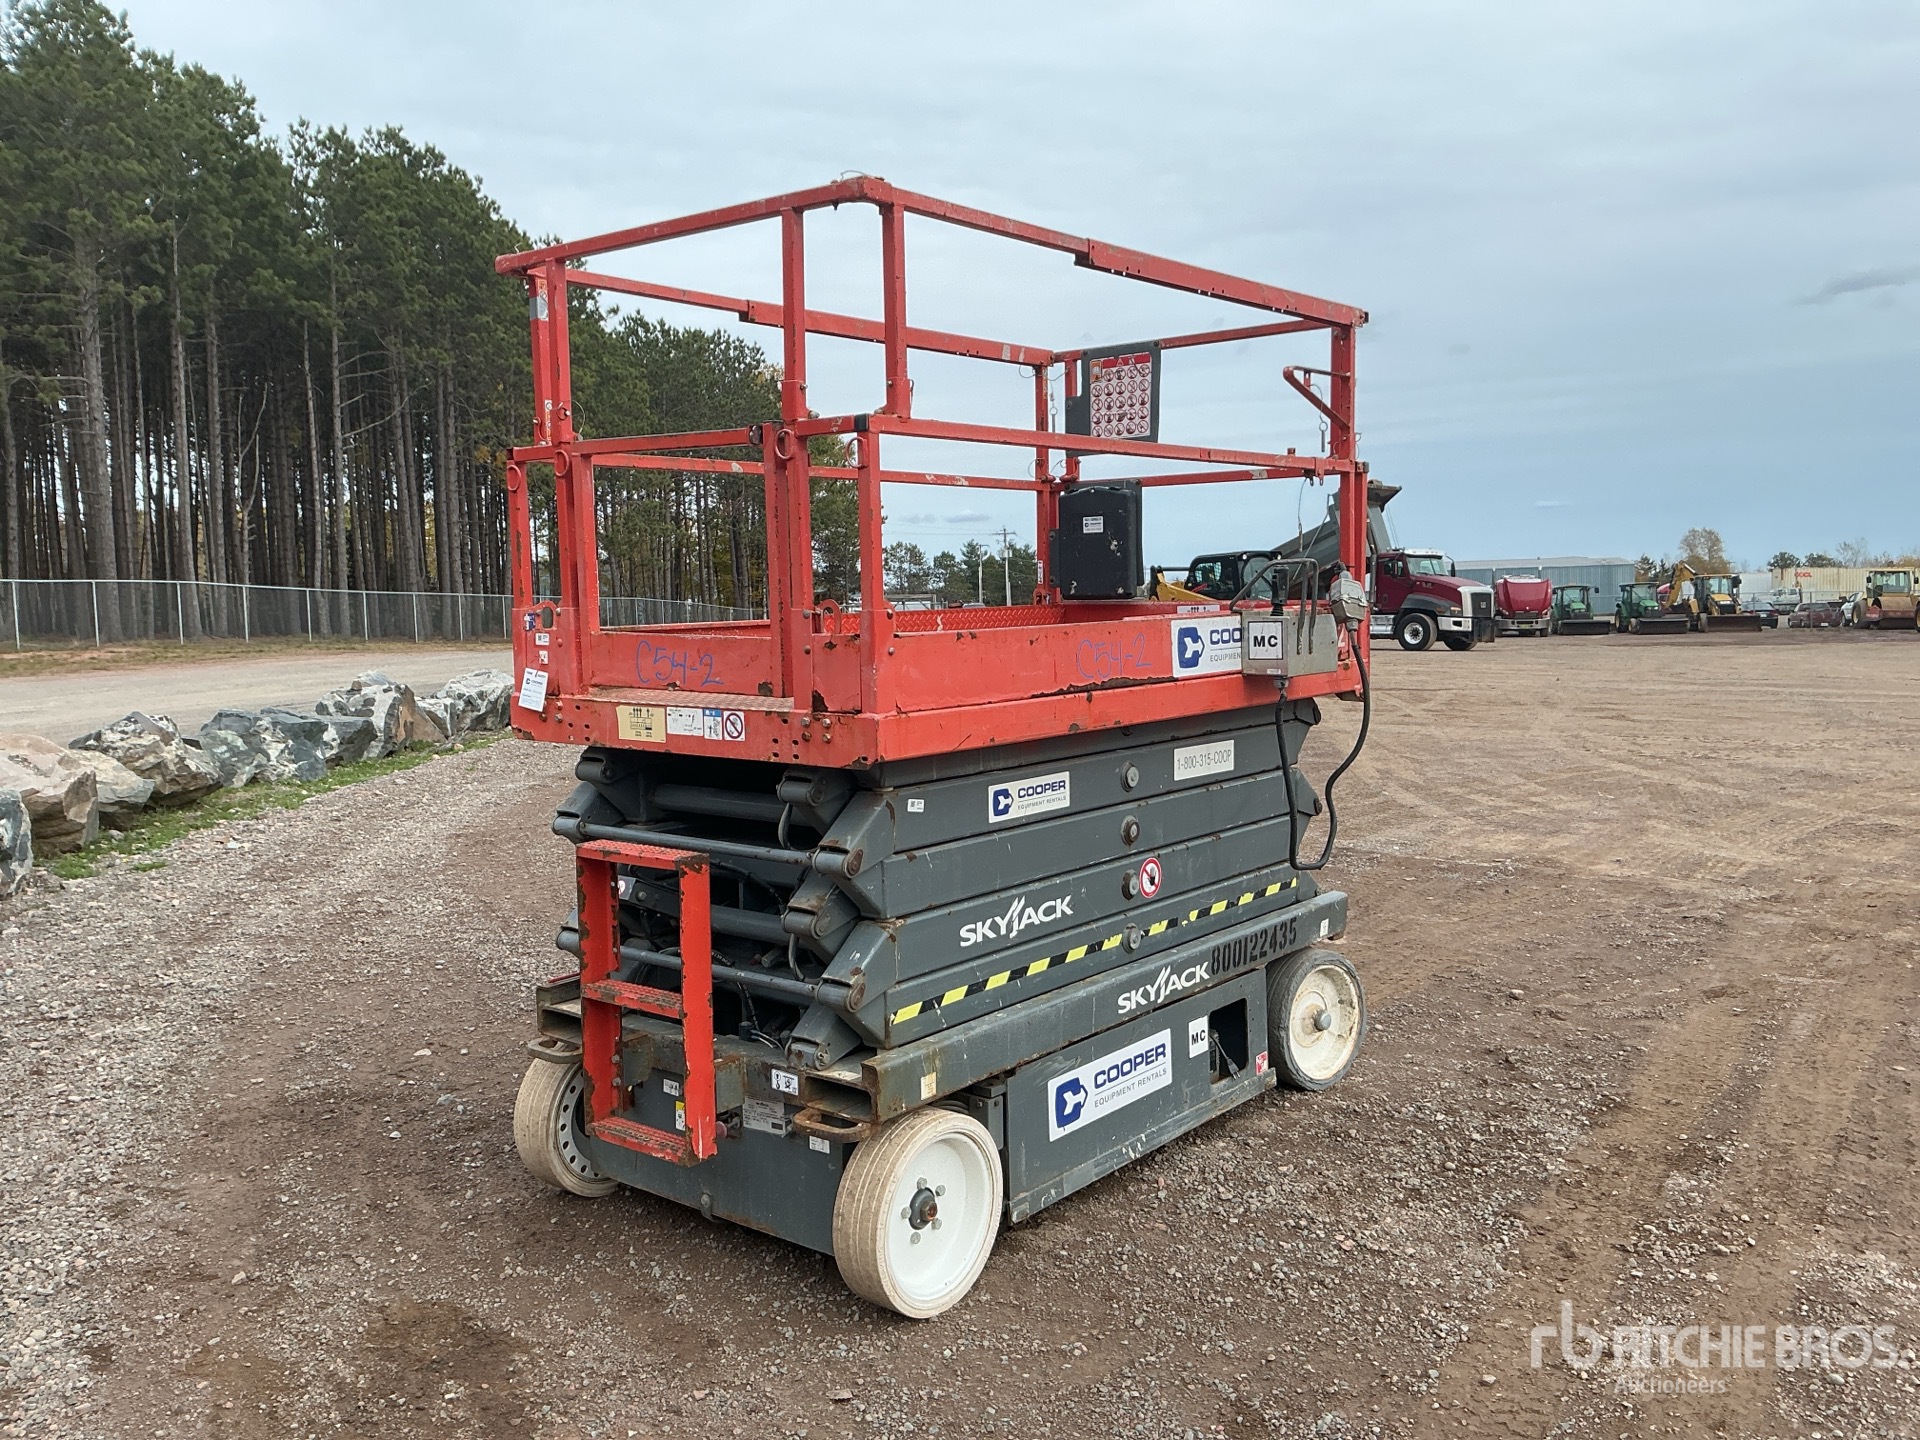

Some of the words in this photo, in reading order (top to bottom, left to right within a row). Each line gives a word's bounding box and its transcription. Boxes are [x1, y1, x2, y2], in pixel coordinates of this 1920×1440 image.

[1209, 627, 1242, 645] COO
[1253, 635, 1278, 648] MC
[636, 640, 725, 687] C54-2
[1209, 652, 1242, 662] EQUIPMEN
[1017, 779, 1067, 799] COOPER
[1017, 799, 1046, 811] EQUIPMENT
[1046, 795, 1067, 804] RENTALS
[960, 894, 1074, 947] SKYJACK
[1117, 961, 1210, 1014] SKYJACK
[1191, 1028, 1206, 1046] MC
[1094, 1042, 1166, 1089] COOPER
[1094, 1082, 1136, 1108] EQUIPMENT
[1137, 1067, 1167, 1088] RENTALS
